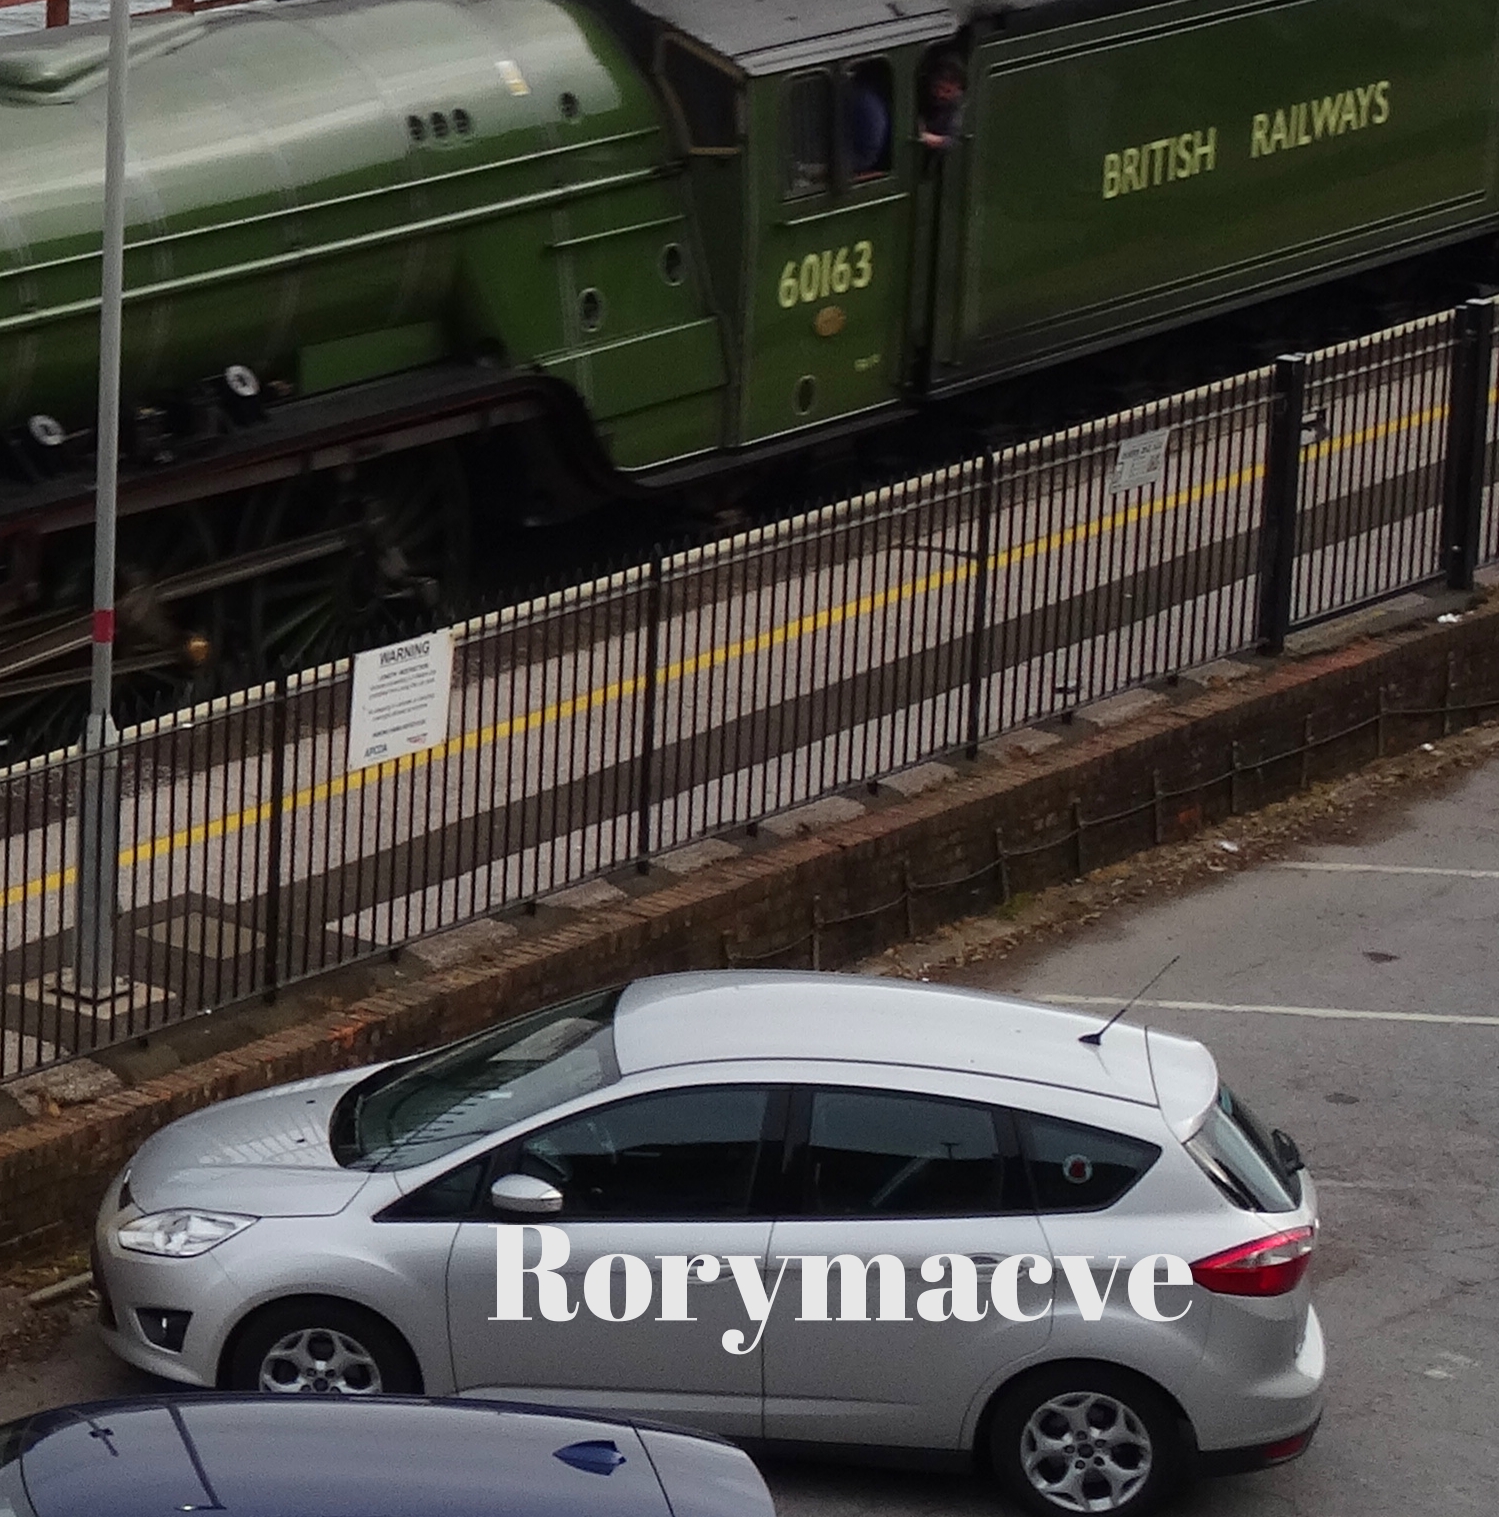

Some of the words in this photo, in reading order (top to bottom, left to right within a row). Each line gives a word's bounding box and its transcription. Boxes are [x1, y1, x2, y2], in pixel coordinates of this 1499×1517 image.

[1103, 127, 1218, 199] BRITISH
[1250, 81, 1392, 158] RAILWAYS
[778, 240, 873, 309] 60163
[380, 641, 430, 664] WARNING
